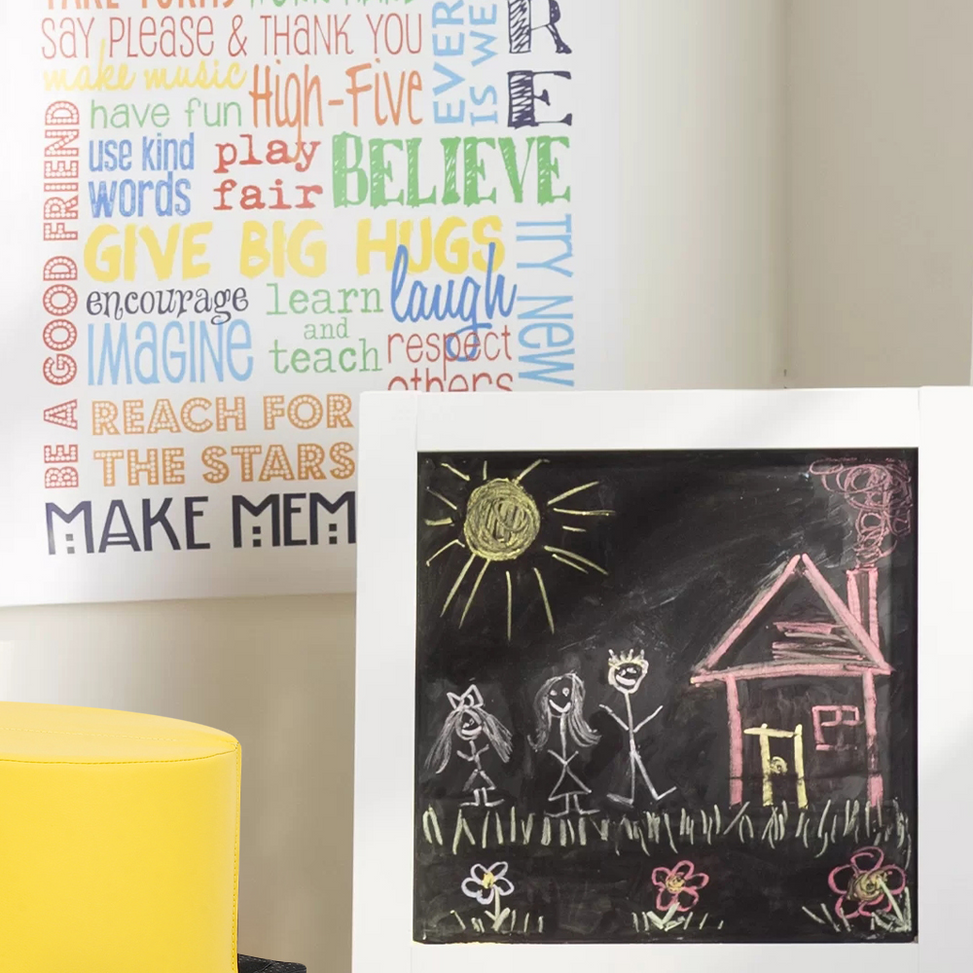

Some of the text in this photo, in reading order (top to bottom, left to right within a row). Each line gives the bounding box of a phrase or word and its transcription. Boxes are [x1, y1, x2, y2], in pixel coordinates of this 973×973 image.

[228, 14, 247, 57] &
[366, 12, 422, 55] YOU
[43, 38, 247, 92] make music
[469, 2, 498, 127] IS WE
[90, 97, 242, 129] have fun
[88, 132, 194, 172] use kind
[213, 134, 321, 174] play
[332, 131, 571, 209] BELIEVE
[88, 172, 191, 218] words
[213, 179, 324, 211] fair
[83, 214, 506, 282] GIVE BIG HUGS
[42, 100, 80, 489] BE A GOOD FRIEND
[86, 287, 249, 326] encourage
[266, 283, 385, 316] learn
[390, 242, 517, 362] laugh
[303, 317, 349, 341] and
[269, 338, 383, 375] teach
[387, 325, 512, 382] respect
[91, 394, 354, 437] REACH FOR
[93, 441, 355, 488] THE STARS
[44, 495, 211, 556] MAKE
